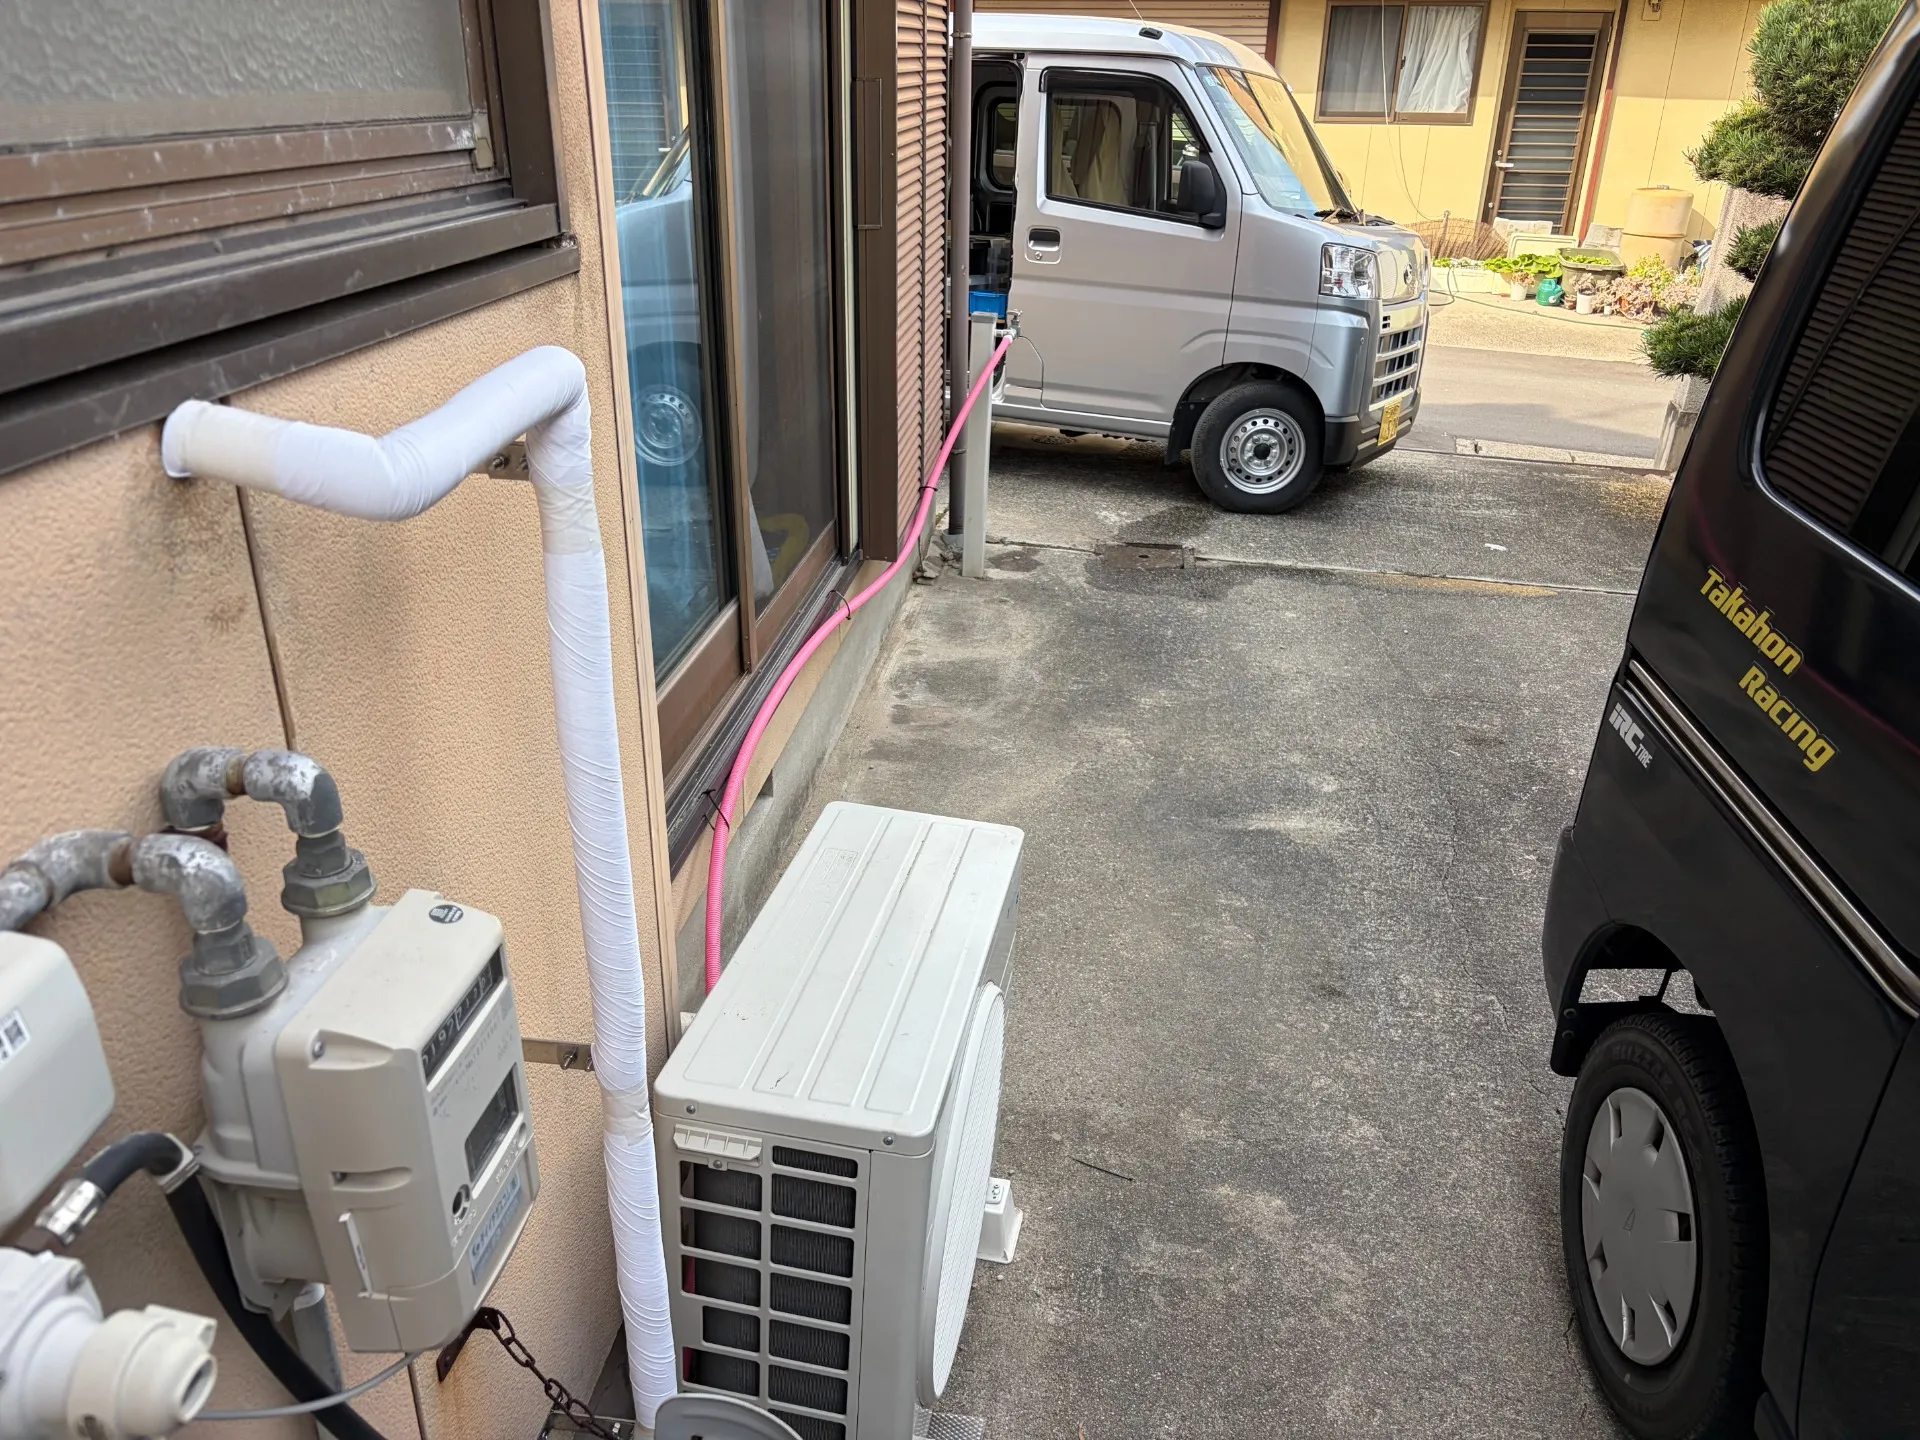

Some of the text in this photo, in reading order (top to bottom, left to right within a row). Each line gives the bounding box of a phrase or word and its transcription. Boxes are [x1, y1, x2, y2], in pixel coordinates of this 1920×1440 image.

[1700, 567, 1802, 676] Takahon
[1635, 743, 1653, 769] TIRE
[1738, 665, 1836, 772] Racing
